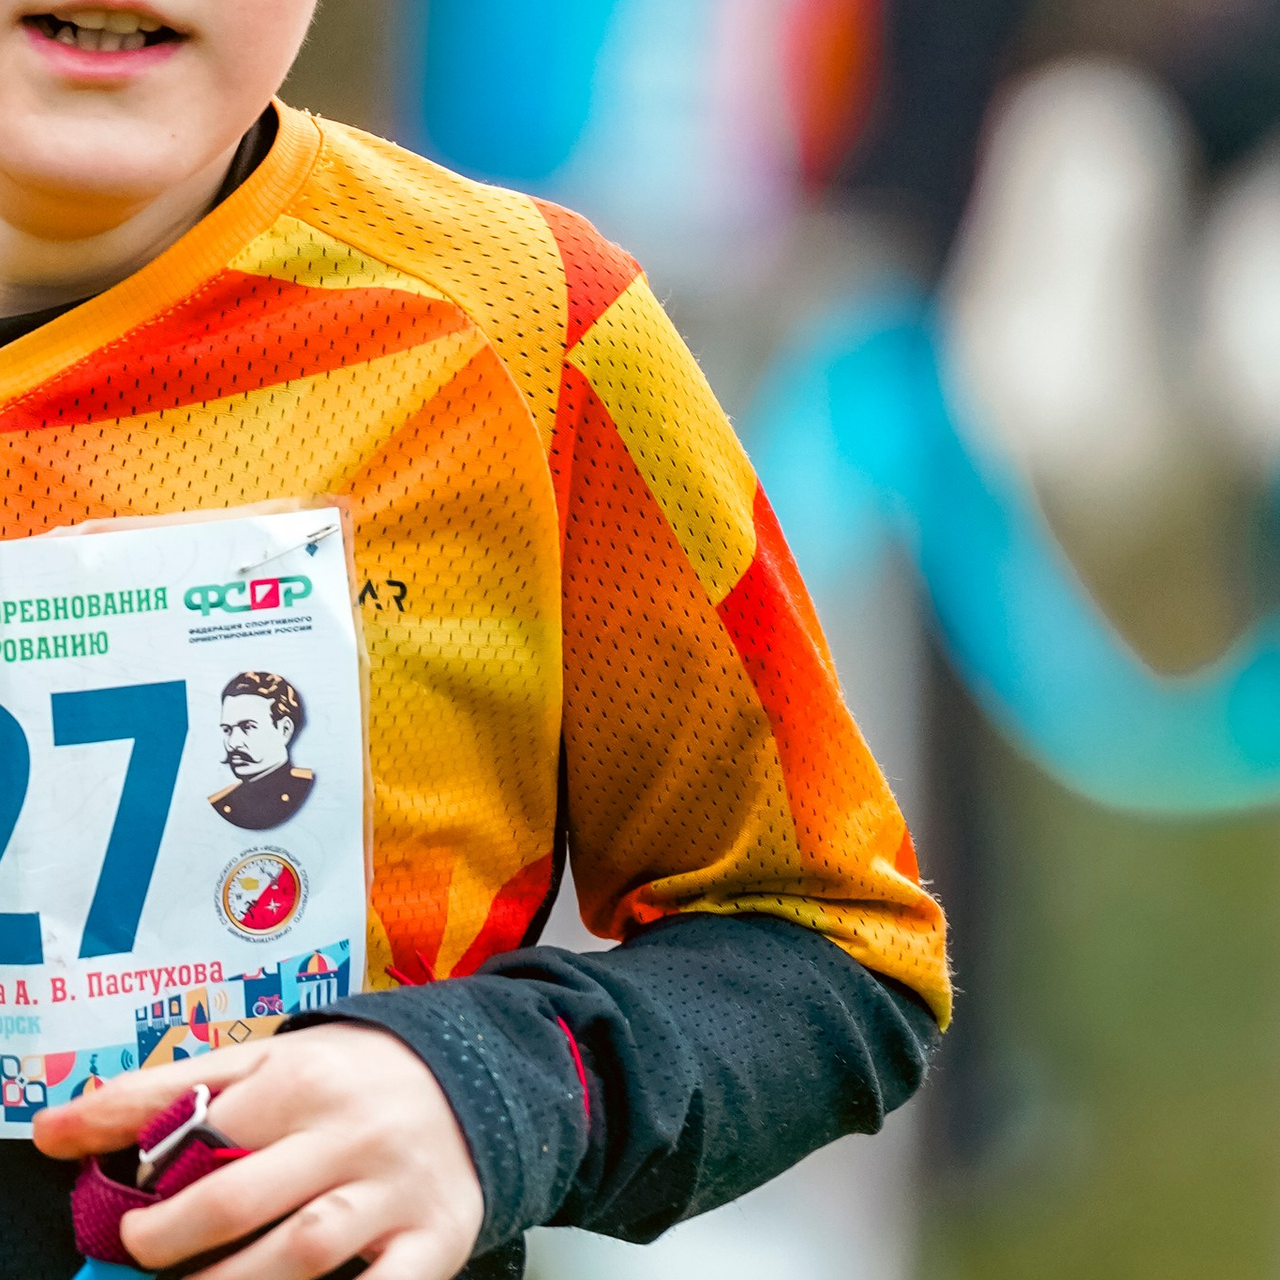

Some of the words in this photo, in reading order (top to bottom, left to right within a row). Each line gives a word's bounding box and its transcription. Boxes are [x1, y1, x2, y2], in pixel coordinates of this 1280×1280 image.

[14, 979, 39, 1006] А.
[50, 977, 77, 1003] В.
[87, 960, 224, 998] Пастухова
